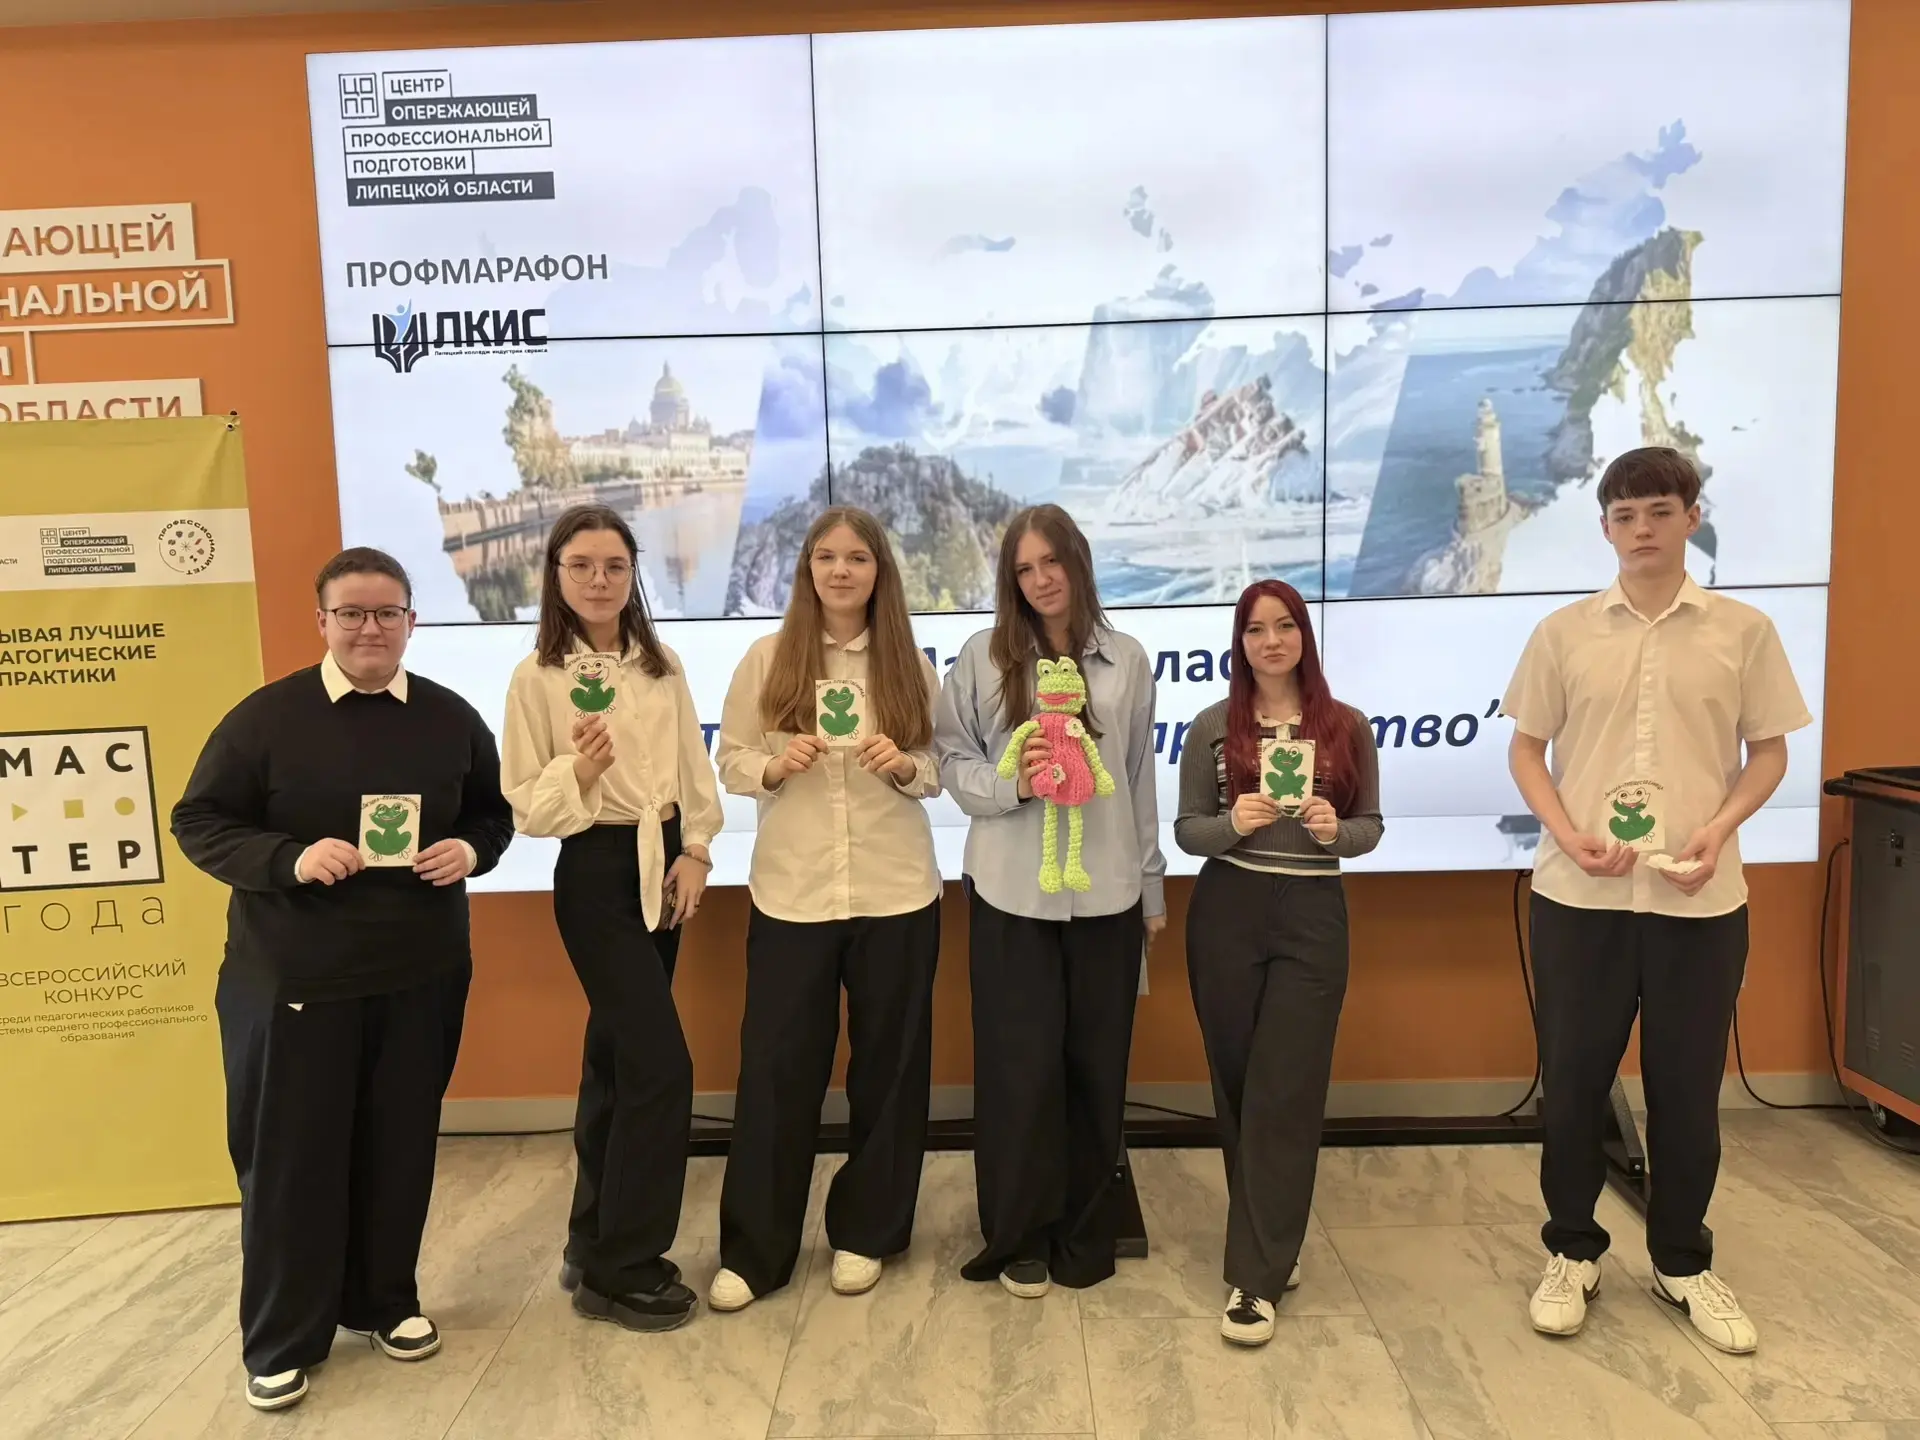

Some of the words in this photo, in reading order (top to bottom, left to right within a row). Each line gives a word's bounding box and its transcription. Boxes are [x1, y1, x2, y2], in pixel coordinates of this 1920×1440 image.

[390, 77, 445, 96] ЦЕНТР
[391, 98, 531, 121] ОПЕРЕЖАЮЩЕЙ
[351, 124, 543, 147] ПРОФЕССИОНАЛЬНОЙ
[353, 155, 467, 175] ПОДГОТОВКИ
[355, 179, 450, 200] ЛИПЕЦКОЙ
[454, 178, 534, 197] ОБЛАСТИ
[2, 212, 175, 259] АЮЩЕЙ
[346, 253, 608, 288] ПРОФМАРАФОН
[433, 308, 548, 349] ЛКИС
[0, 396, 182, 422] БЛАСТИ
[62, 529, 87, 537] ЦЕНТР
[63, 537, 125, 546] ОПЕРЕЖАЮЩЕЙ
[45, 546, 131, 556] ПРОФЕССИОНАЛЬНОЙ
[158, 519, 215, 575] ПРОФЕССИОНАЛИТЕТ
[46, 556, 98, 565] ПОДГОТОВКИ
[48, 565, 88, 574] ЛИПЕЦКОЙ
[89, 564, 123, 573] ОБЛАСТИ
[0, 627, 62, 644] ЫВАЯ
[69, 623, 165, 641] ЛУЧШИЕ
[0, 645, 157, 665] АГОГИЧЕСКИЕ
[0, 668, 116, 687] ПРАКТИКИ
[12, 839, 141, 875] ТЕР
[3, 896, 165, 935] года
[0, 958, 187, 988] ВСЕРОССИЙСКИЙ
[44, 984, 144, 1005] КОНКУРС
[34, 1008, 125, 1023] педагогических
[127, 1003, 194, 1019] работников
[36, 1021, 90, 1035] среднего
[92, 1013, 208, 1032] профессионального
[60, 1029, 135, 1044] образования
